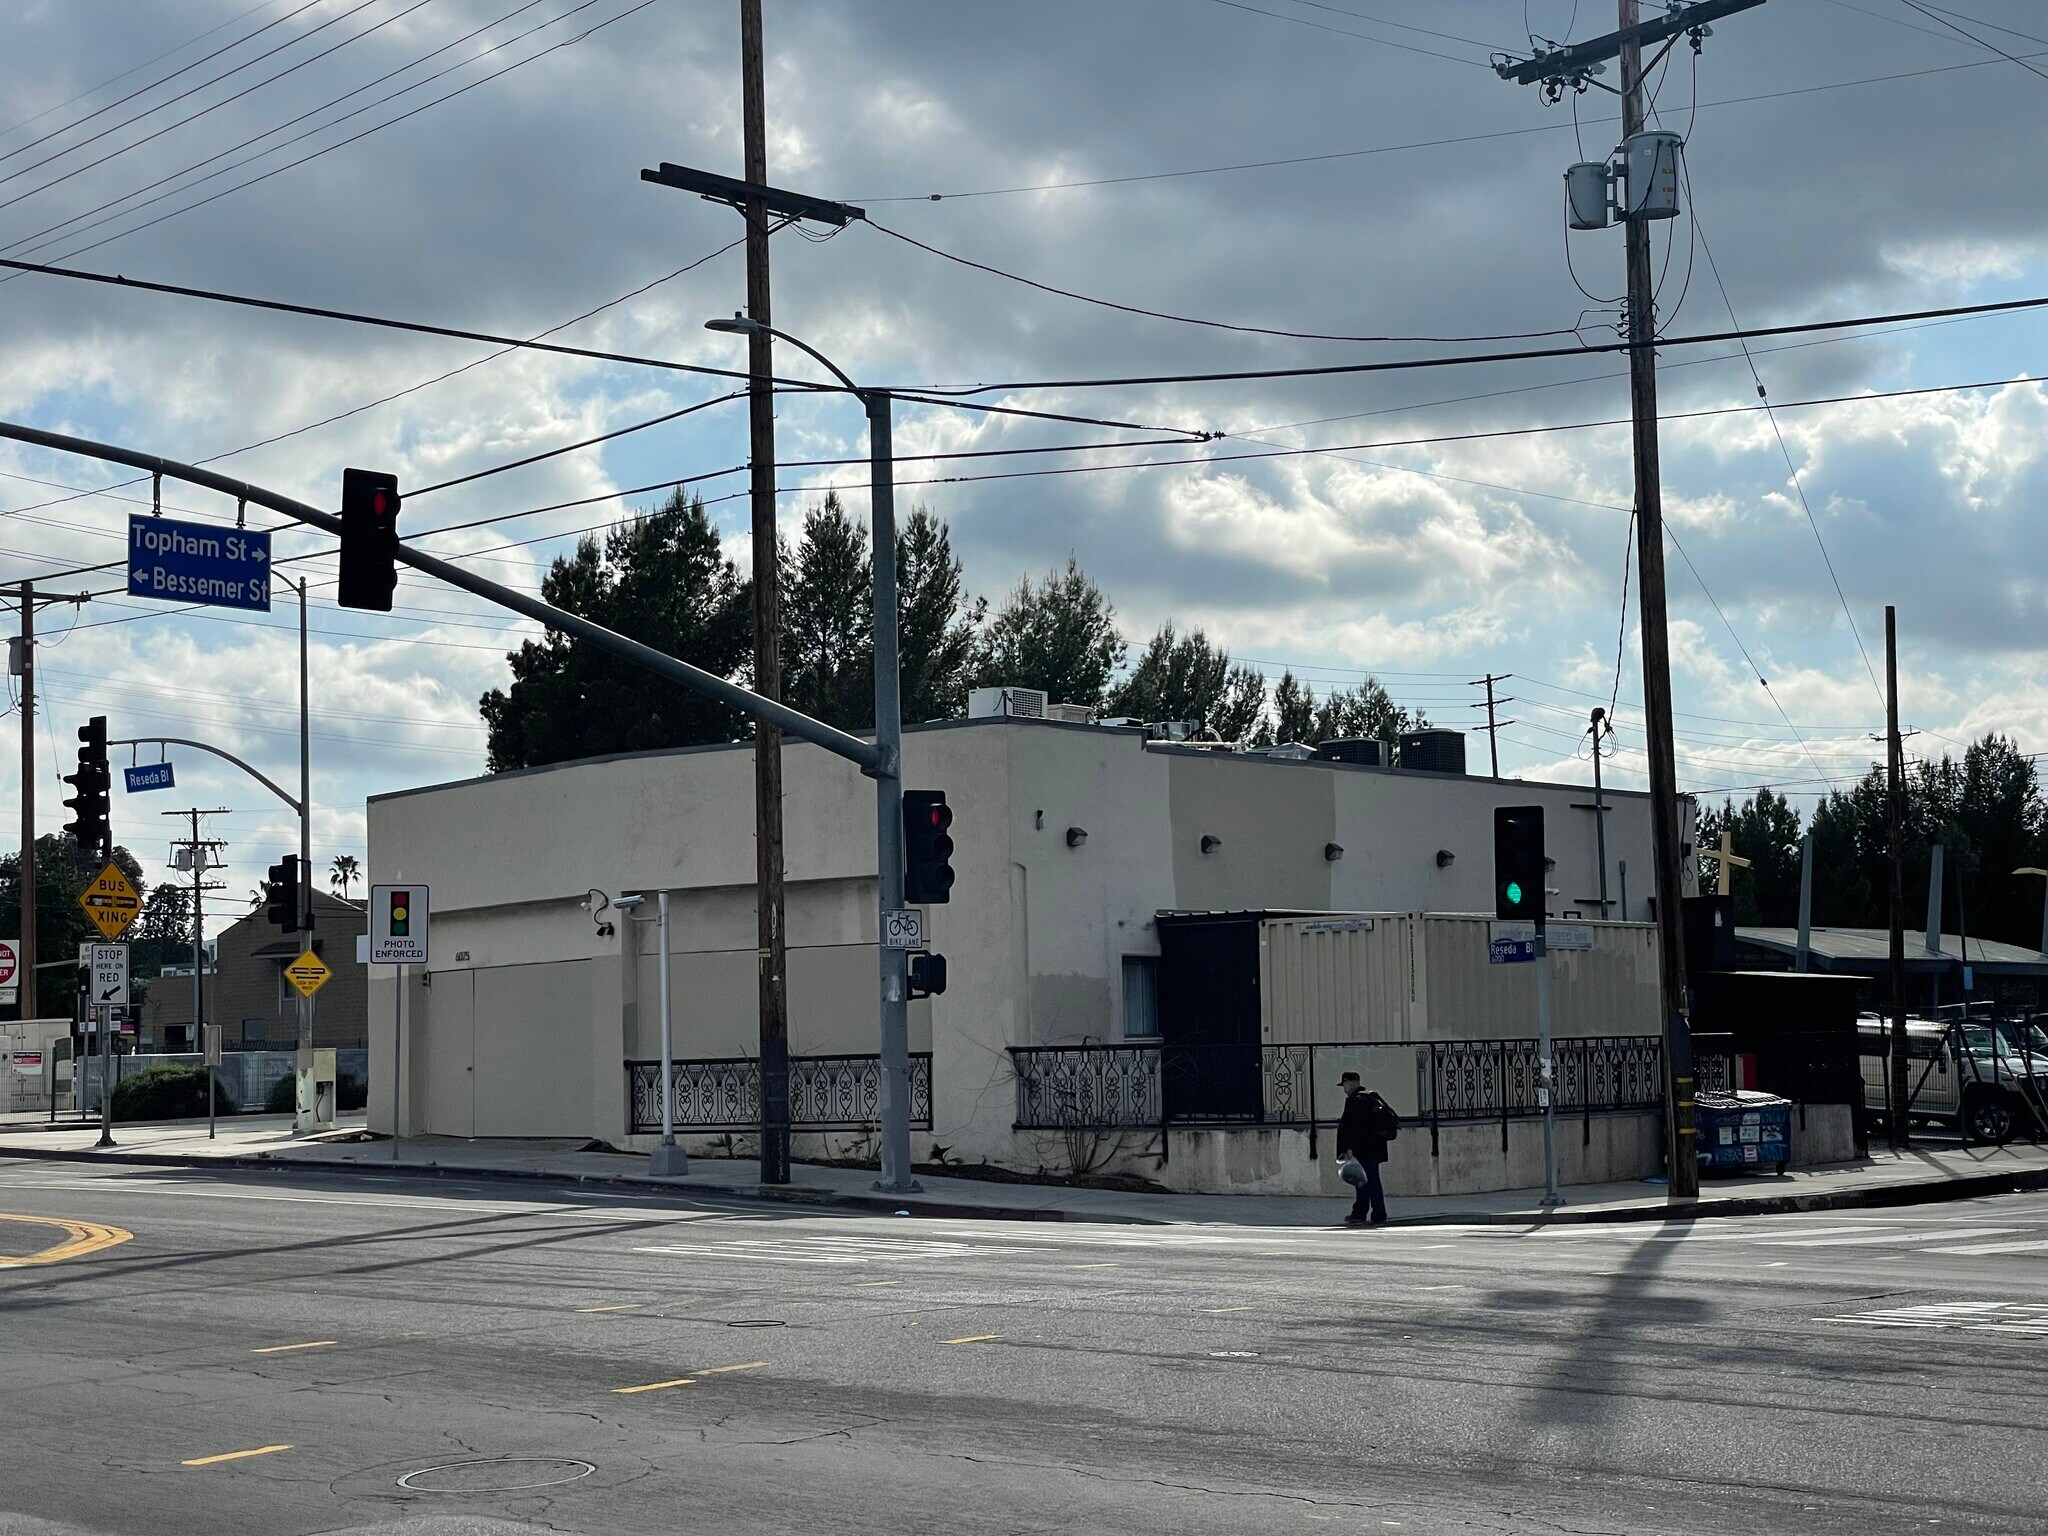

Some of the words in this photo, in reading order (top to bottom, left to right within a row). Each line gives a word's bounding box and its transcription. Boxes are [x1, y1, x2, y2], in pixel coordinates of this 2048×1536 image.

[132, 524, 219, 557] Topham
[225, 537, 246, 561] St
[153, 566, 244, 599] Bessemer
[249, 578, 268, 603] St
[129, 772, 160, 787] Reseda
[160, 769, 170, 783] Bl
[99, 879, 125, 892] BUS
[97, 910, 128, 923] XING
[384, 940, 415, 948] PHOTO
[904, 938, 919, 946] LANE
[1490, 944, 1517, 955] Reseda
[1525, 942, 1533, 953] Bl
[97, 949, 123, 960] STOP
[375, 950, 424, 958] ENFORCED
[99, 972, 119, 982] RED
